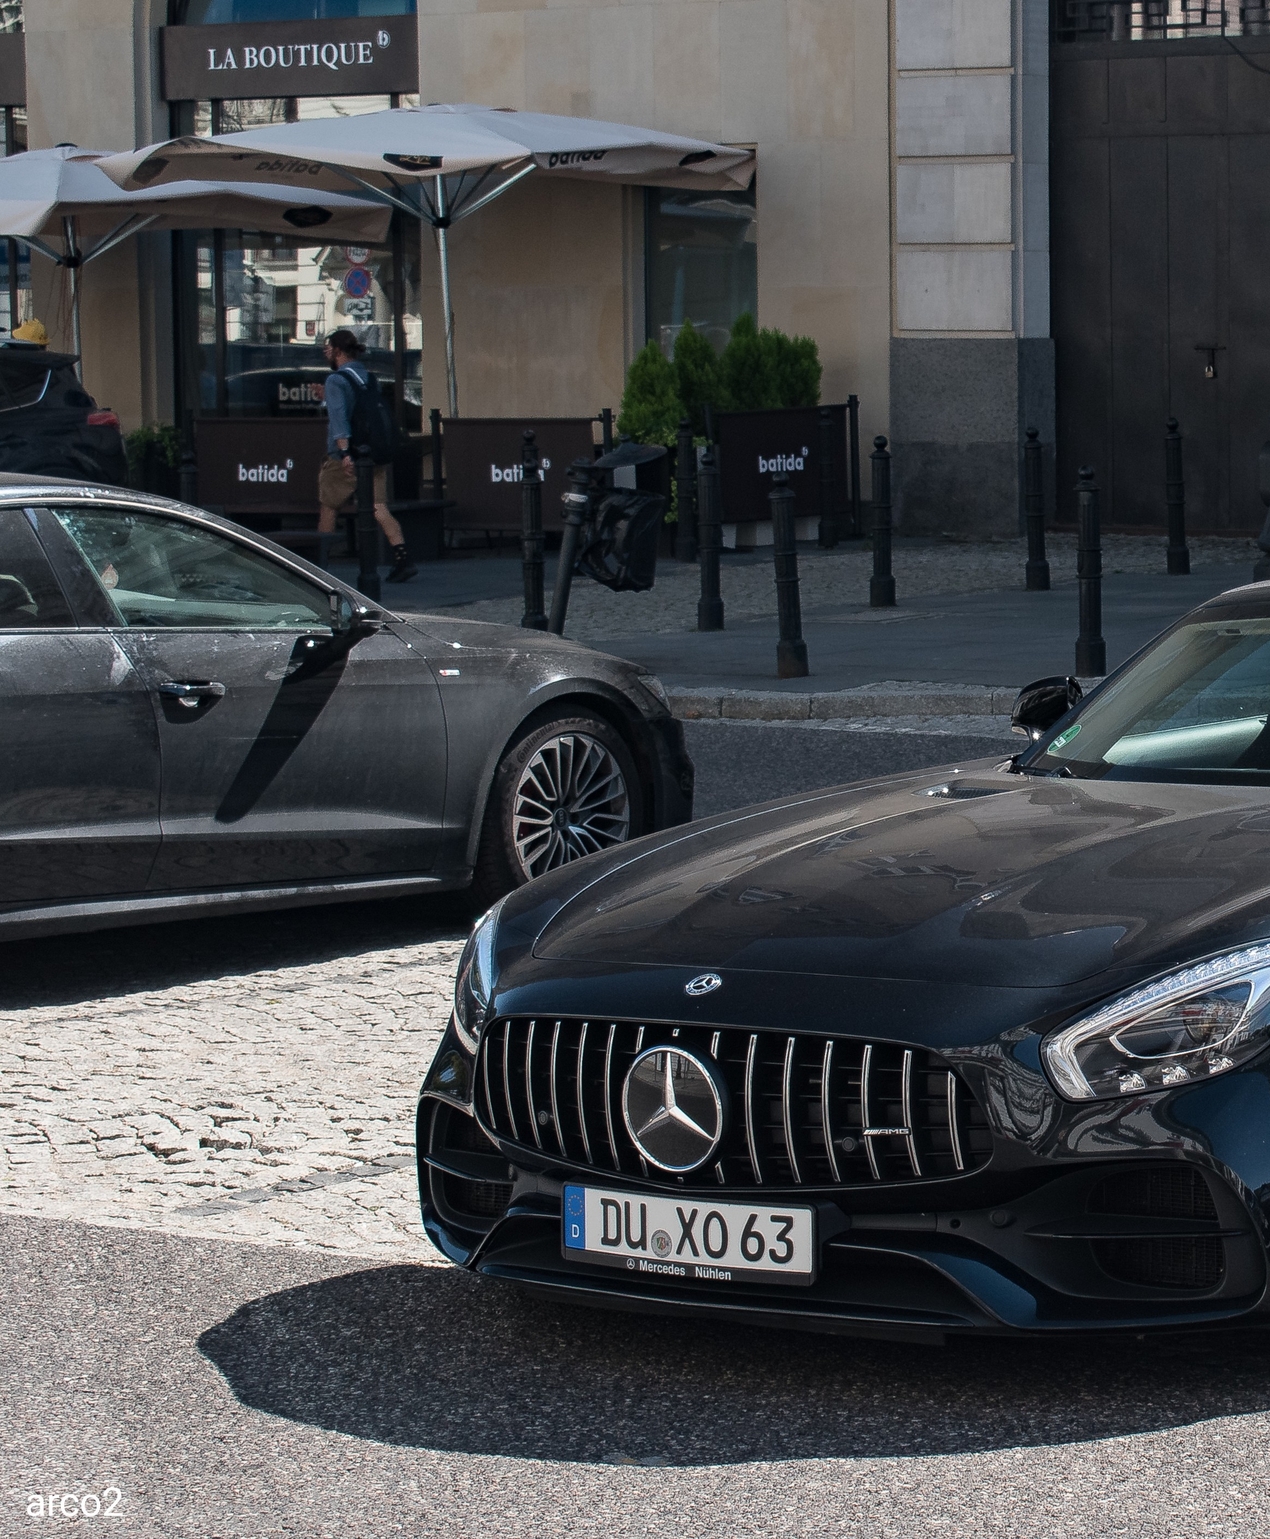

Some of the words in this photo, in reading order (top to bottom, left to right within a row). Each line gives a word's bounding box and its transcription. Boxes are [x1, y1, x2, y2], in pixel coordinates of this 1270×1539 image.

[207, 48, 239, 70] LA
[243, 42, 374, 70] BOUTIQUE
[238, 464, 288, 482] batida
[759, 454, 804, 473] batida
[571, 1224, 580, 1238] D
[600, 1197, 647, 1251] DU
[675, 1206, 729, 1259] XO
[740, 1213, 794, 1264] 63
[640, 1260, 686, 1276] Mercedes
[695, 1266, 732, 1280] Nühlen
